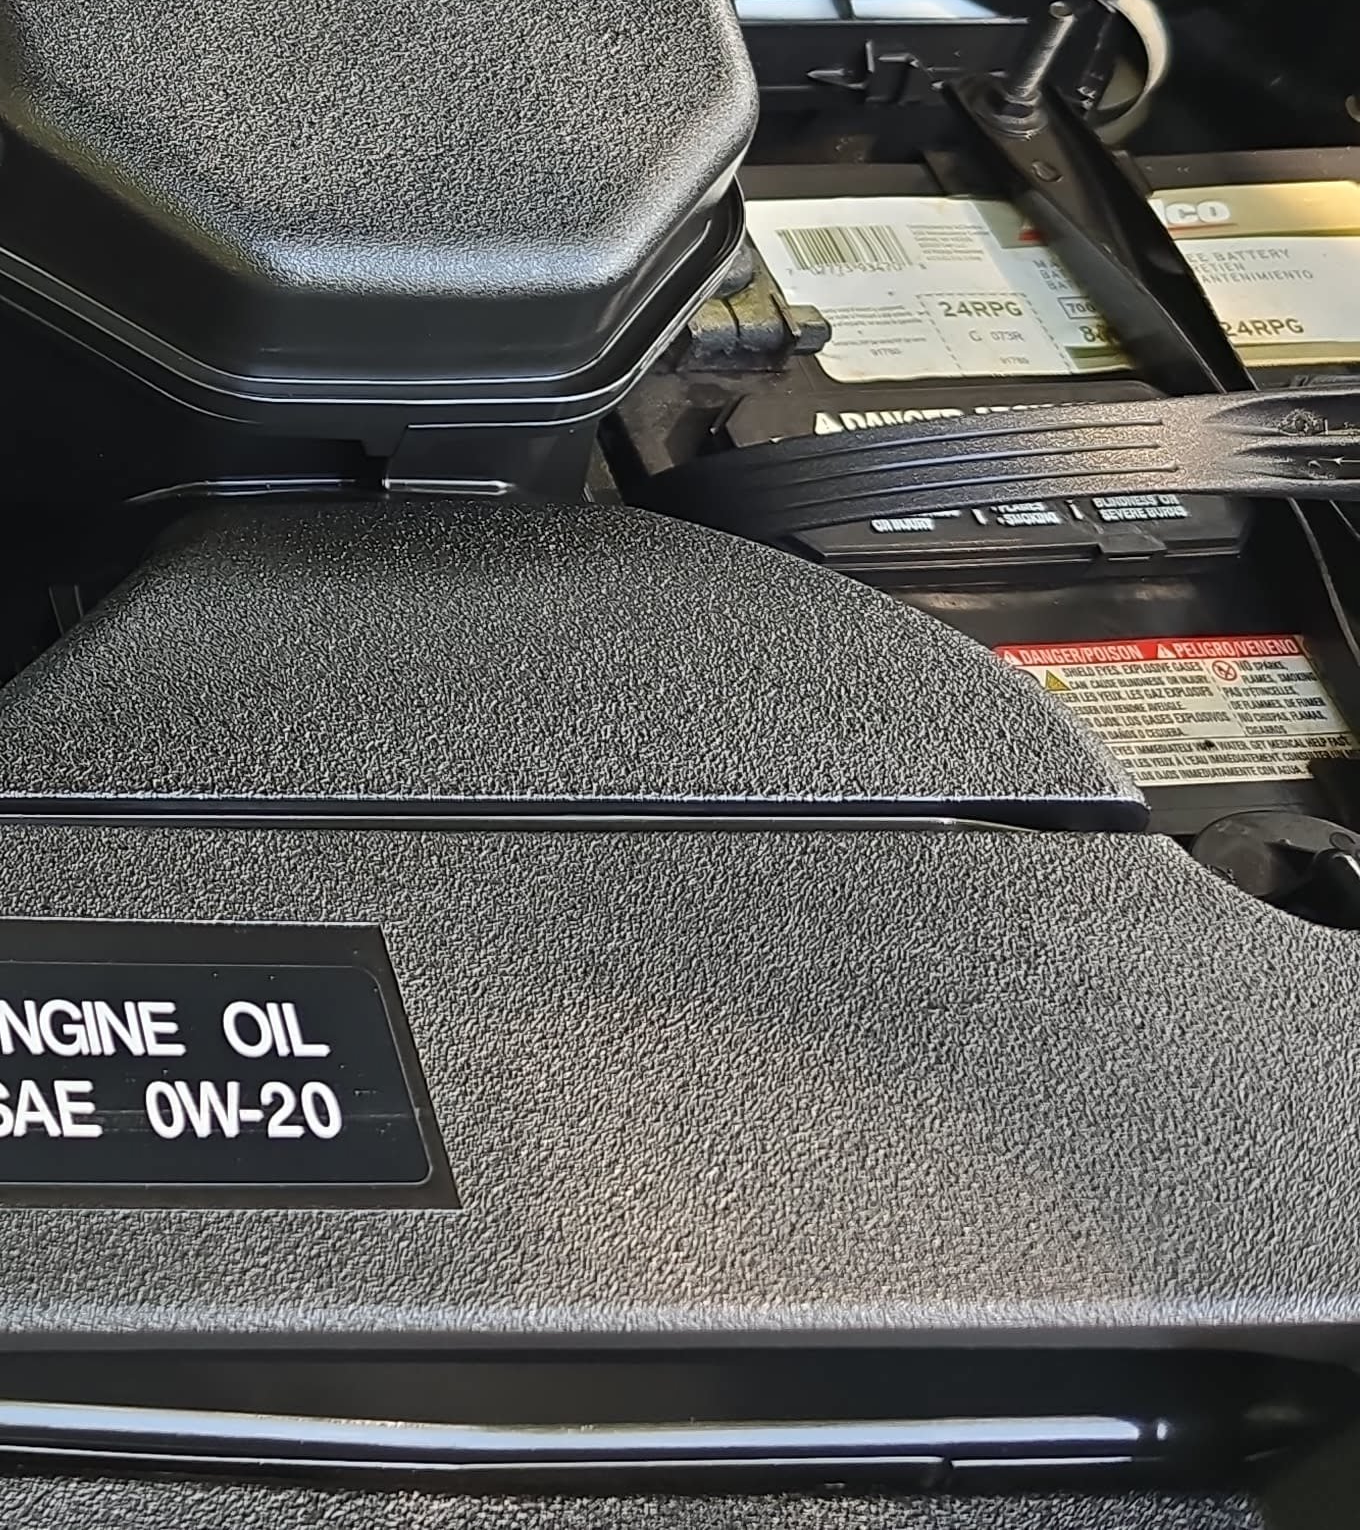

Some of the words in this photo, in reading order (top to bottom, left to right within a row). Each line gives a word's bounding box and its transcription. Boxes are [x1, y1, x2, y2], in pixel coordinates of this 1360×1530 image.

[1201, 270, 1314, 284] ANTENIMIENTO
[938, 301, 1024, 318] 24RPG
[1019, 645, 1144, 665] DANGER/POISON
[1174, 638, 1300, 658] PELIGRO/VENENO
[1062, 666, 1095, 677] SHIELD
[1121, 663, 1173, 675] EXPLOSIVE
[1171, 661, 1204, 672] GASES
[1069, 680, 1088, 689] CAN
[1090, 679, 1118, 689] CAUSE
[1117, 676, 1165, 688] BLINDNESS
[1079, 691, 1098, 702] LES
[1125, 689, 1145, 700] LES
[1144, 688, 1165, 698] GAZ
[1100, 704, 1113, 714] OU
[1121, 715, 1142, 726] LOS
[1141, 713, 1174, 725] GASES
[1173, 711, 1231, 724] EXPLOSIVOS
[1110, 745, 1135, 756] EYES
[1134, 741, 1193, 754] IMMEDIATELY
[1249, 739, 1266, 750] GET
[1266, 737, 1308, 749] MEDICAL
[1305, 736, 1327, 747] HELP
[1133, 757, 1152, 767] LES
[1151, 756, 1176, 767] YEUX
[1136, 770, 1156, 781] LOS
[1154, 769, 1180, 780] OJOS
[1179, 766, 1259, 779] INMEDIATAMENTE
[1257, 765, 1278, 776] CON
[222, 1000, 331, 1058] OIL
[144, 1080, 343, 1140] 0W-20
